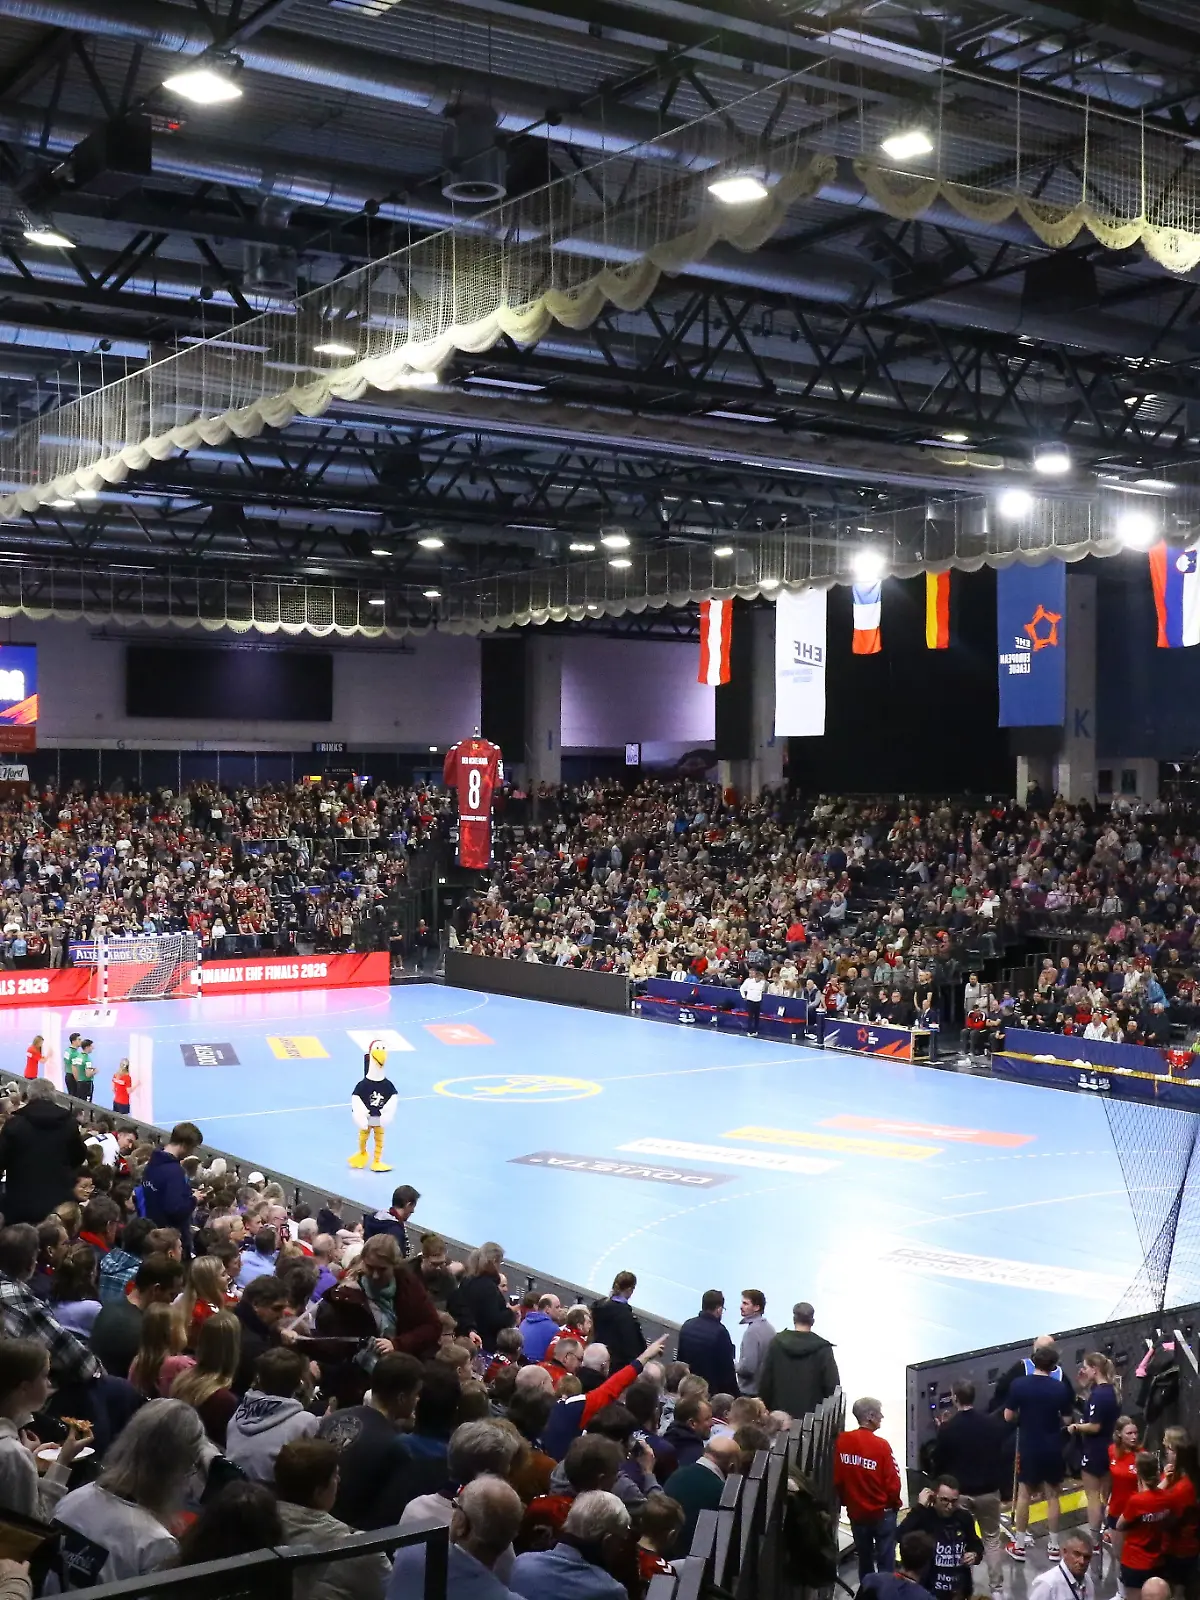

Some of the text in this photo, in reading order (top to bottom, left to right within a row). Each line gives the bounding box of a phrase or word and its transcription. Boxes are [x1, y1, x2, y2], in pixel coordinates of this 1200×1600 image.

[1074, 708, 1091, 738] K
[315, 743, 343, 752] DRINKS
[468, 769, 481, 809] 8
[245, 966, 264, 982] EHF
[265, 964, 299, 980] FINALS
[301, 963, 328, 978] 2026
[0, 978, 49, 995] LS 2026
[547, 1157, 713, 1185] DOVISTA
